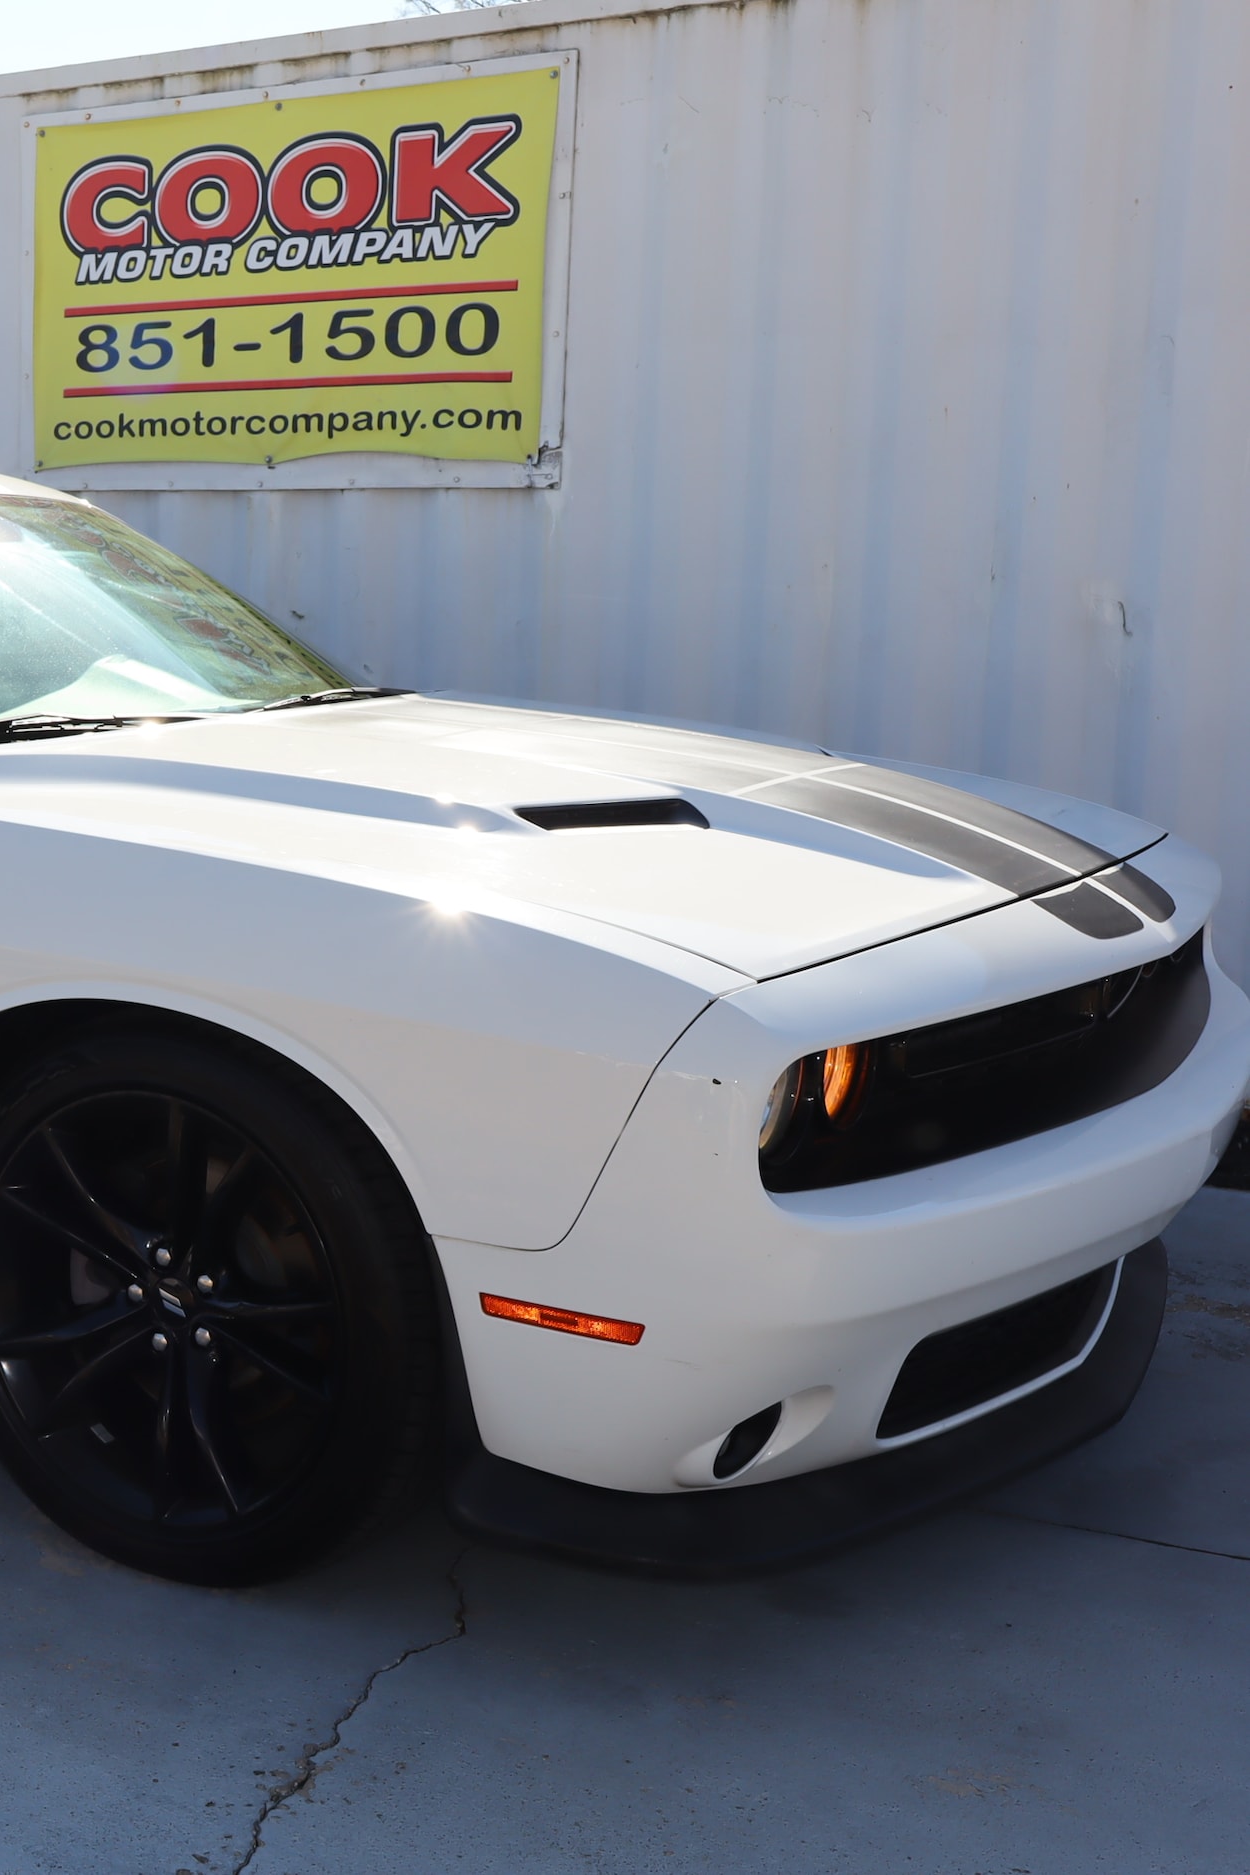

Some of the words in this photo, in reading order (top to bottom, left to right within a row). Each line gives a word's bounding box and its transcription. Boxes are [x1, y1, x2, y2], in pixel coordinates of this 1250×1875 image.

[61, 114, 521, 252] COOK
[76, 243, 233, 285] MOTOR
[246, 222, 495, 273] COMPANY
[75, 302, 500, 373] 851-1500
[53, 408, 522, 441] cookmotorcompany.com
